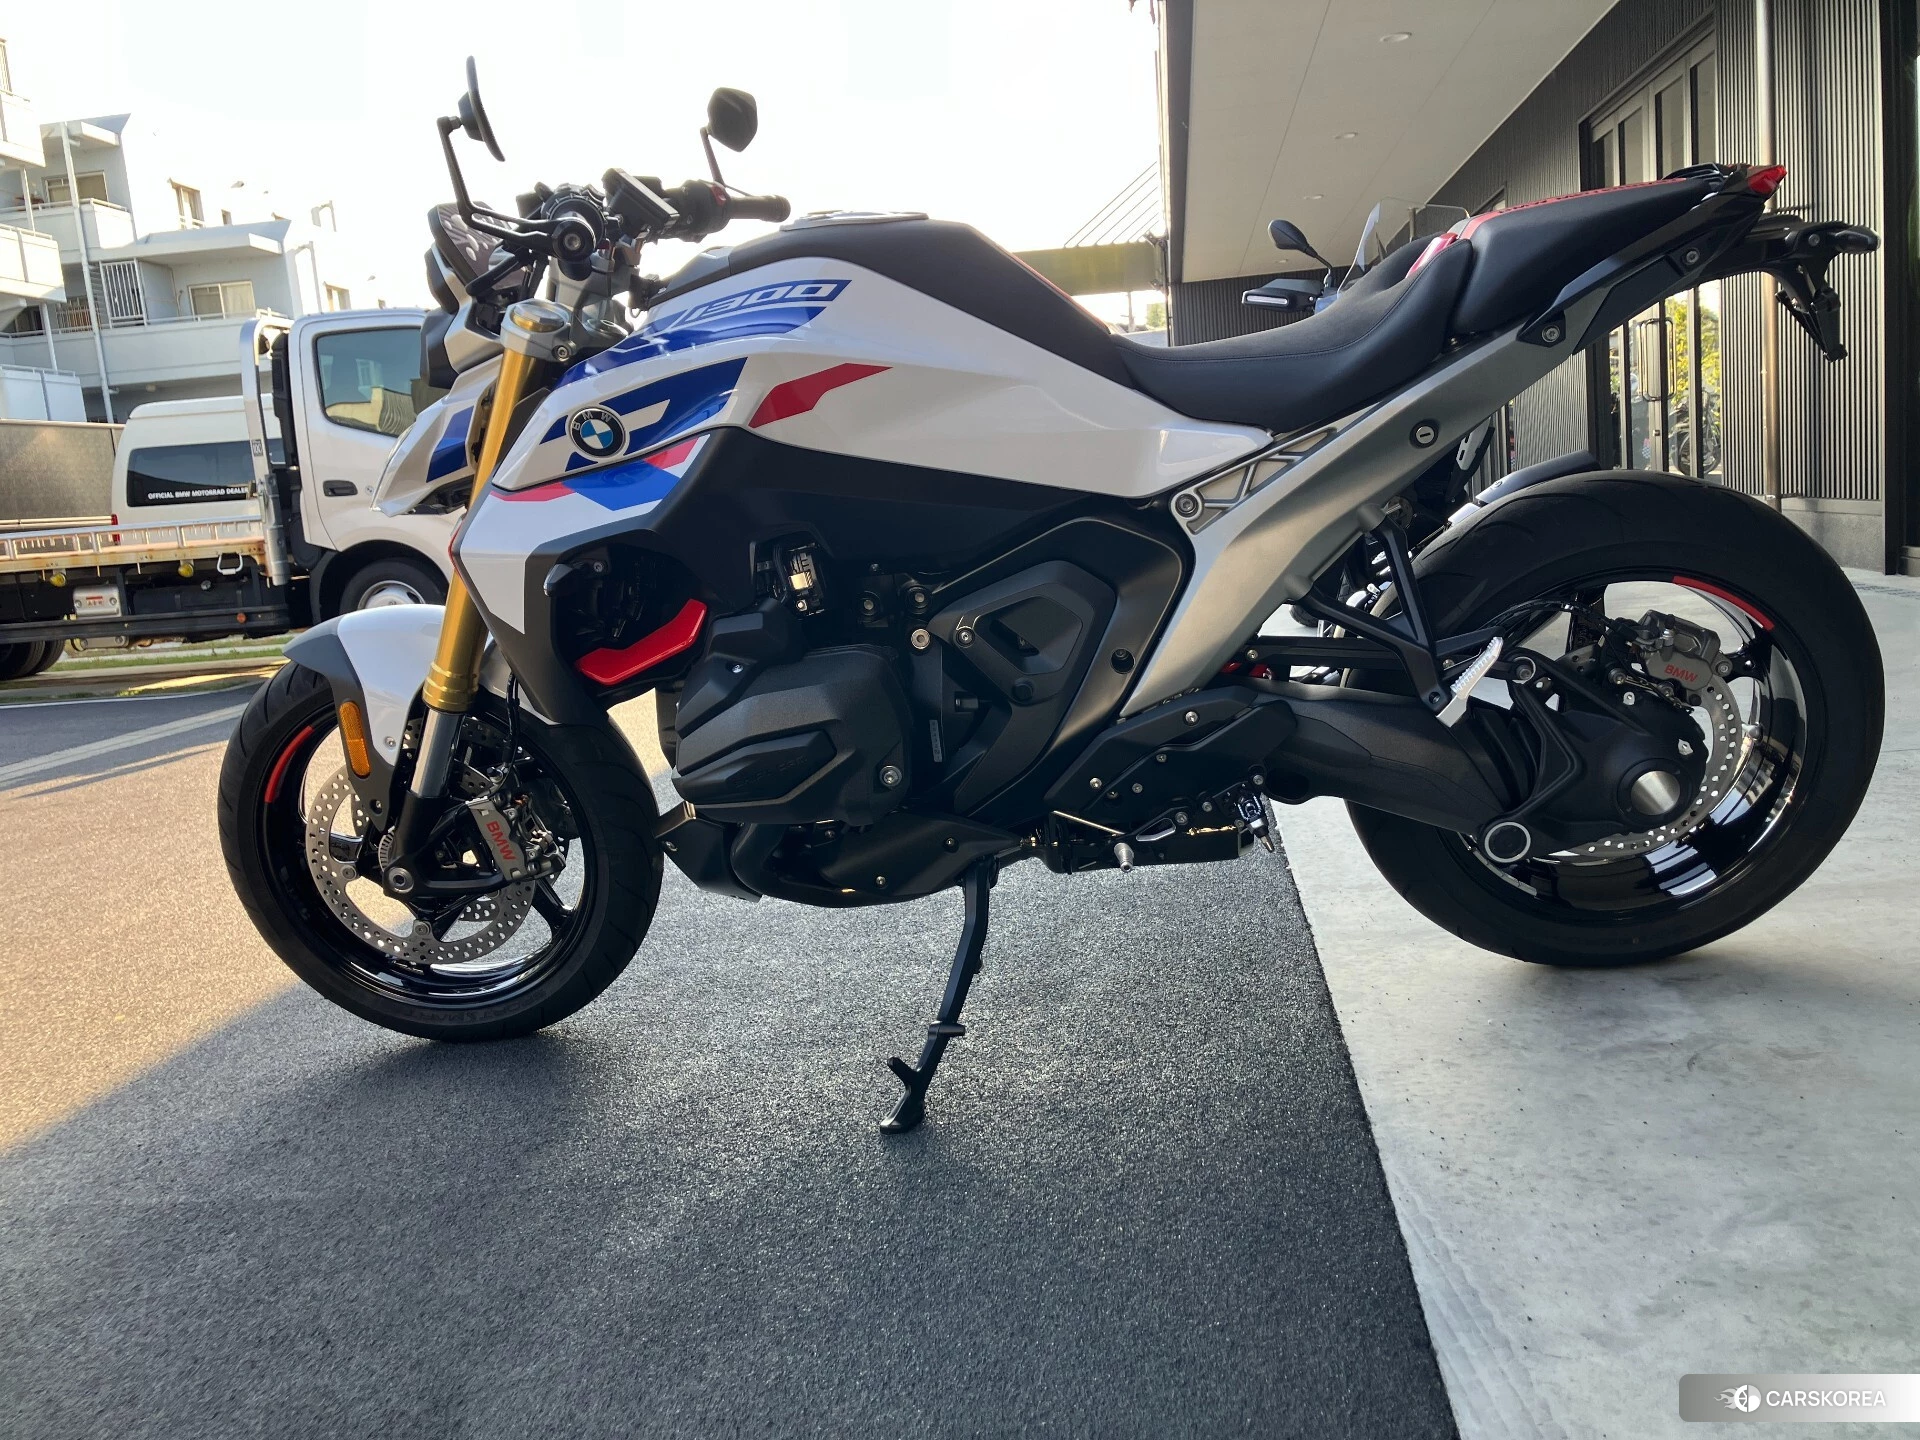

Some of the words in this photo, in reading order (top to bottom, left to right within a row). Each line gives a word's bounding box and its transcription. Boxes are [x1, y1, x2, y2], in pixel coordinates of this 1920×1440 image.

[572, 410, 611, 430] BMW
[148, 491, 174, 499] OFFICIAL
[175, 490, 190, 498] BMW
[191, 488, 225, 497] MOTORRAD
[1664, 664, 1697, 681] BMW
[486, 820, 516, 860] BMW
